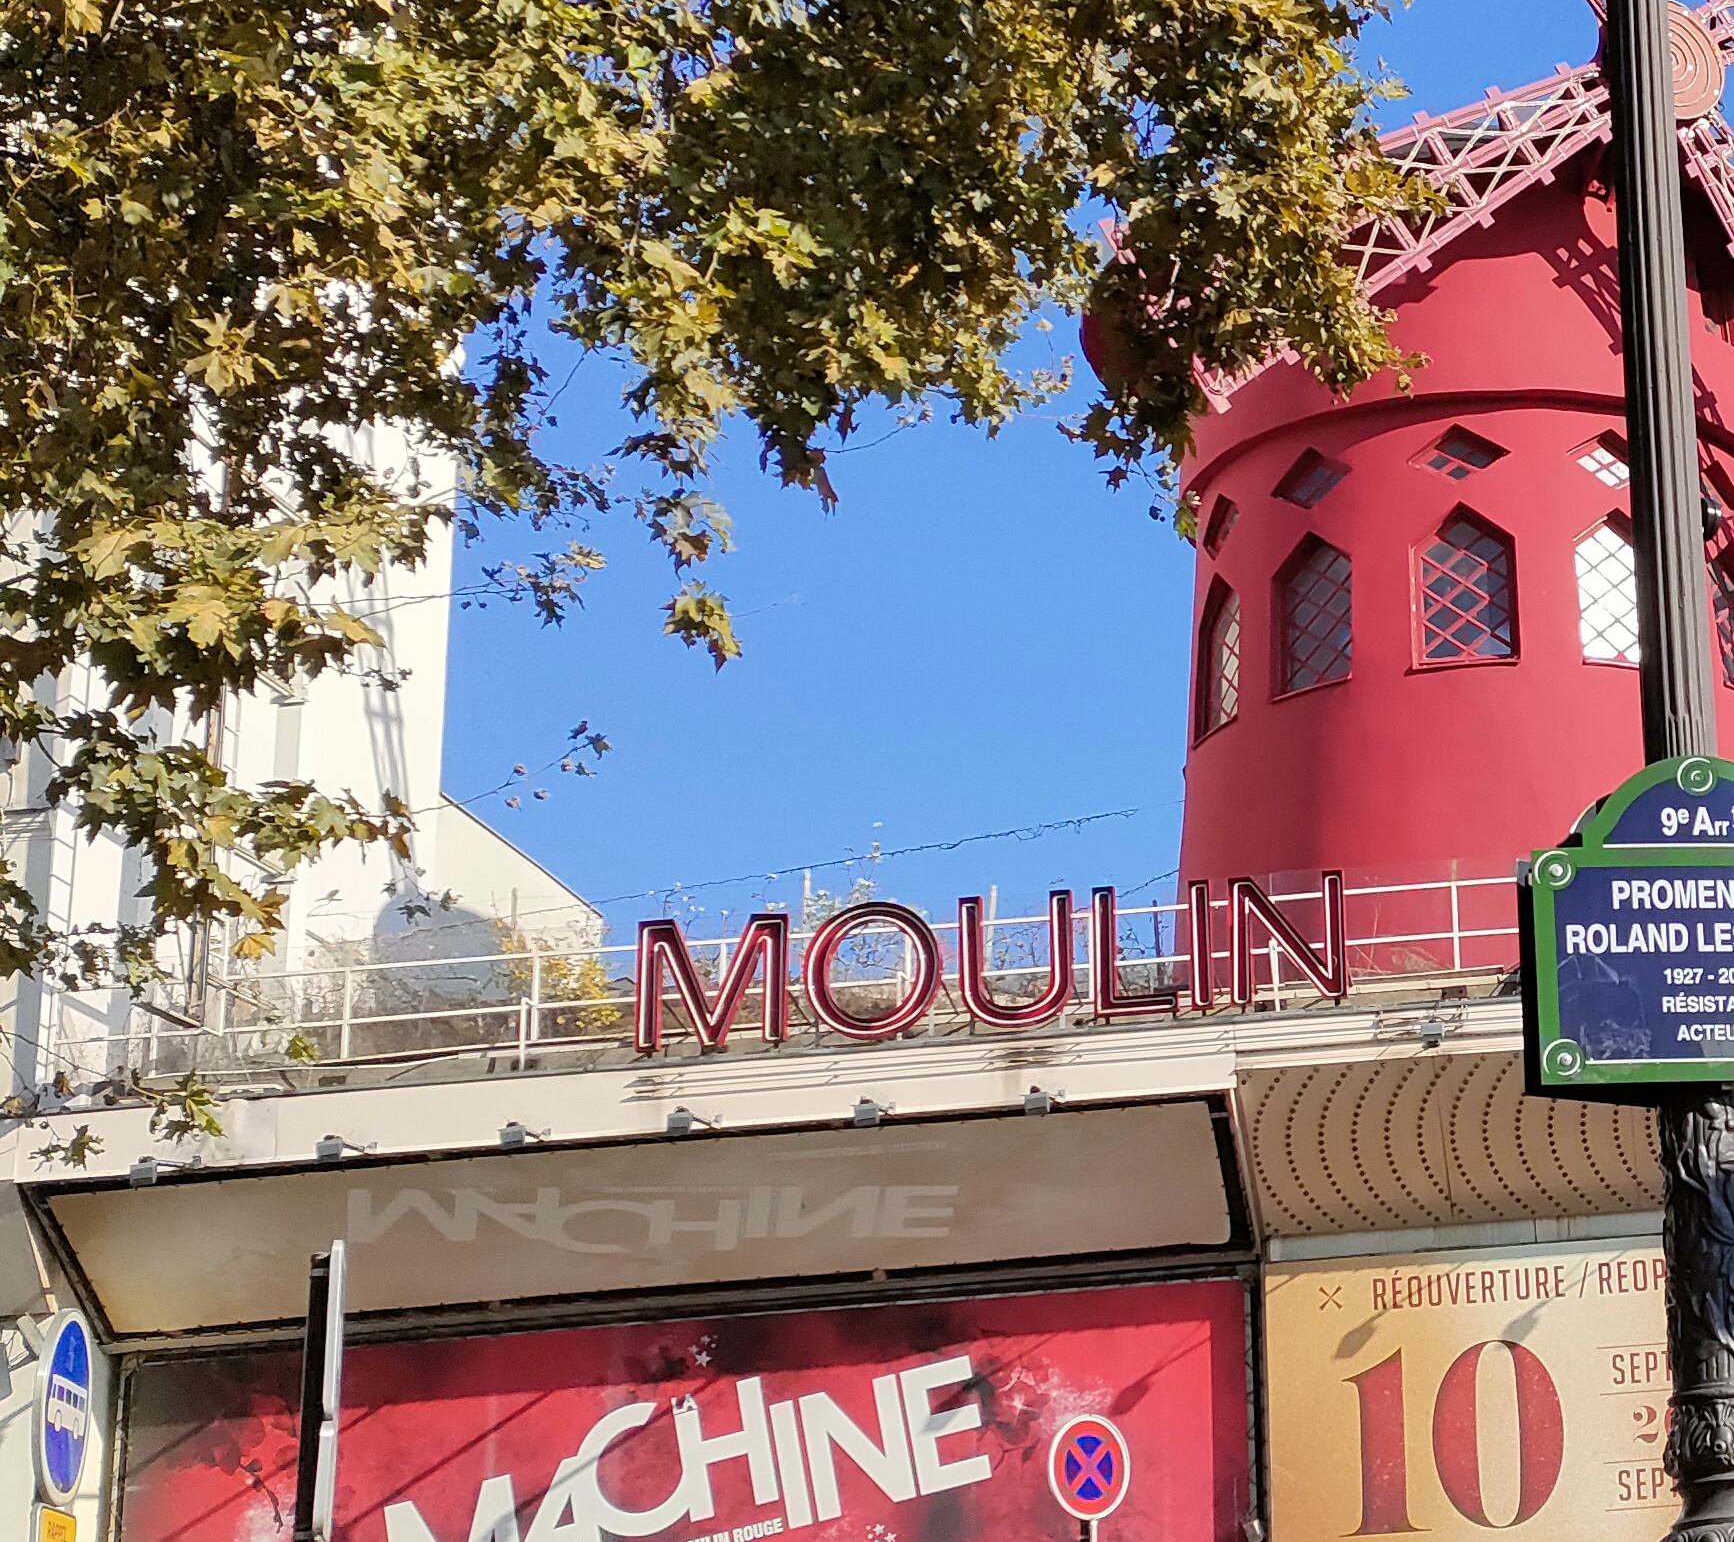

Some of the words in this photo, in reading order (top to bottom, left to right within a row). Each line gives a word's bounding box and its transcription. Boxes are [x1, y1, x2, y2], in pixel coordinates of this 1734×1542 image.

[1661, 807, 1690, 836] 9e
[1565, 922, 1689, 954] ROLAND
[634, 869, 1349, 1053] MOULIN
[1663, 968, 1704, 984] 1927
[1372, 1268, 1566, 1310] RÉOUVERTURE
[671, 1394, 698, 1414] LA
[1338, 1338, 1564, 1538] 10
[733, 1517, 784, 1542] ROUGE
